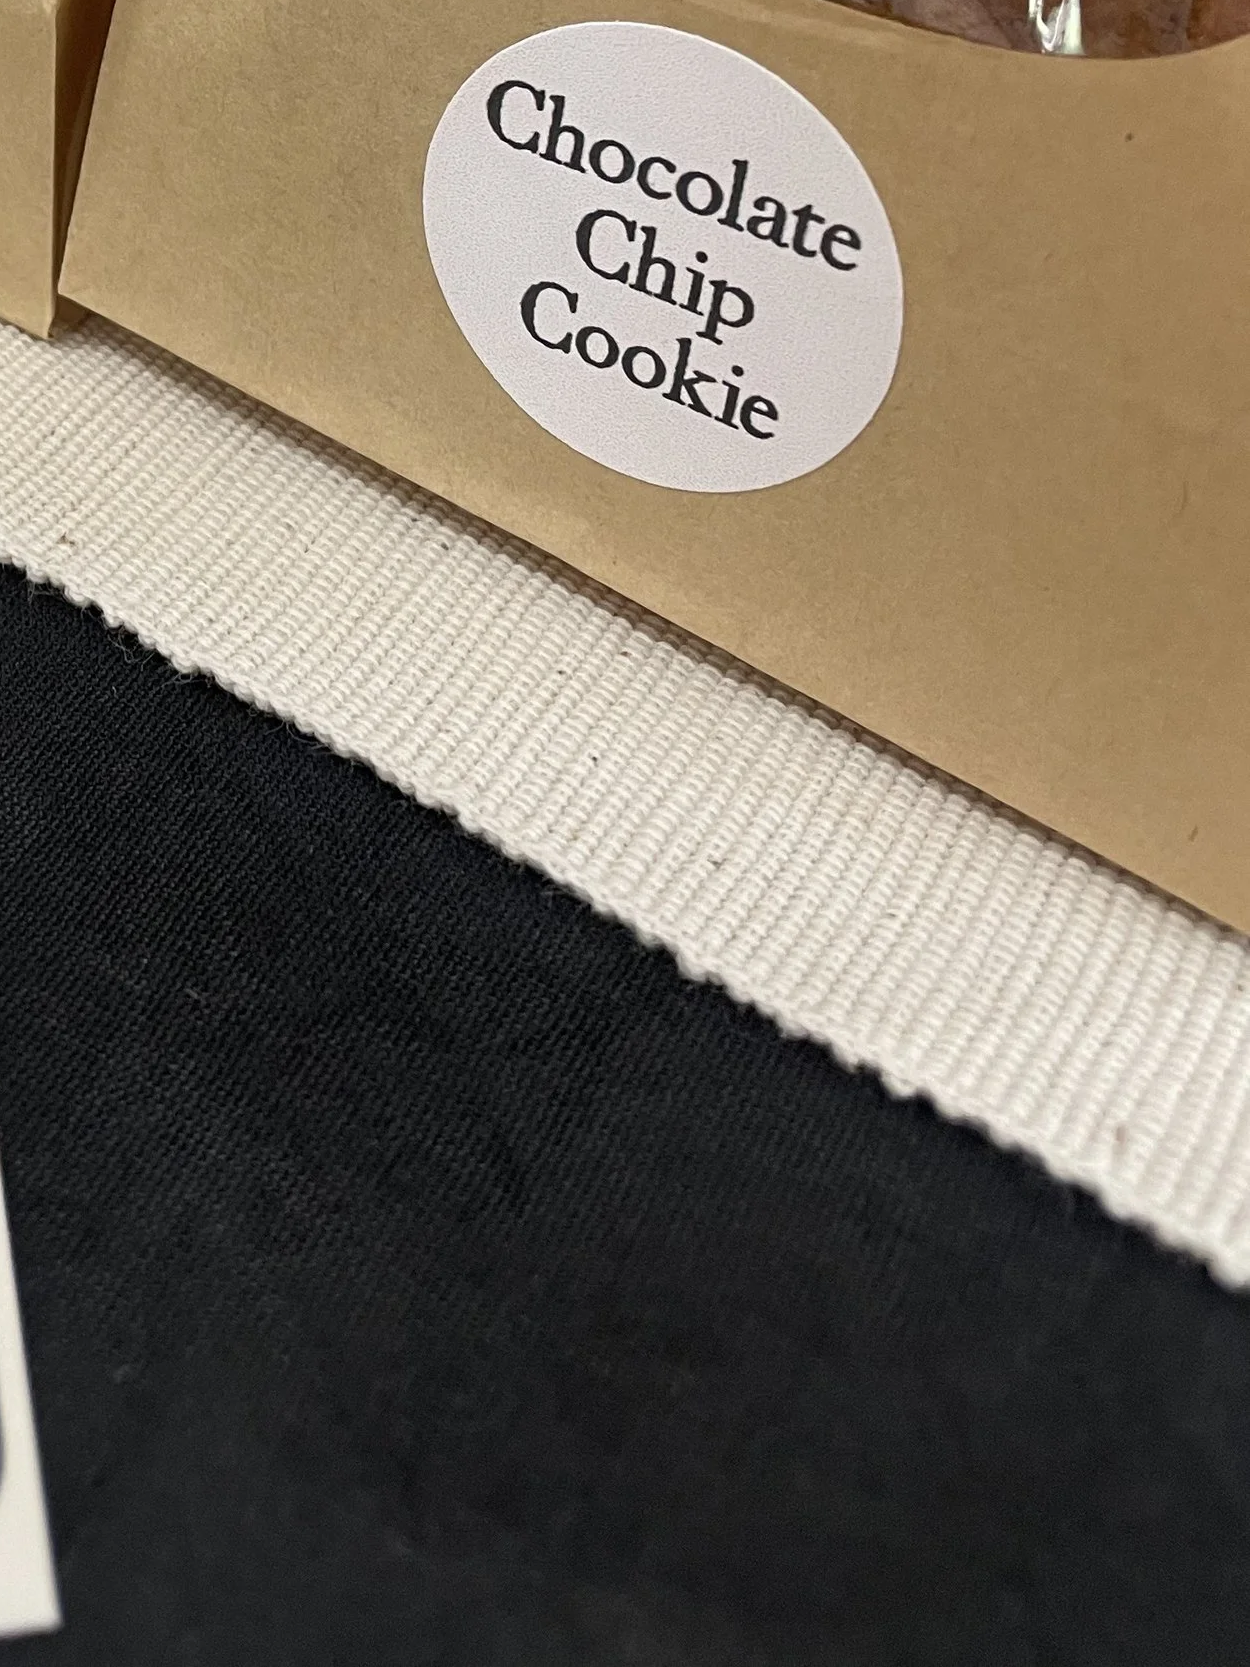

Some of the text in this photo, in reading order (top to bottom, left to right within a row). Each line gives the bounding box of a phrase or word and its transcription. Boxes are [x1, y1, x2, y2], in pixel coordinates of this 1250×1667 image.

[486, 79, 862, 272] Chocolate
[575, 209, 755, 345] Chip
[519, 281, 780, 440] Cookie
